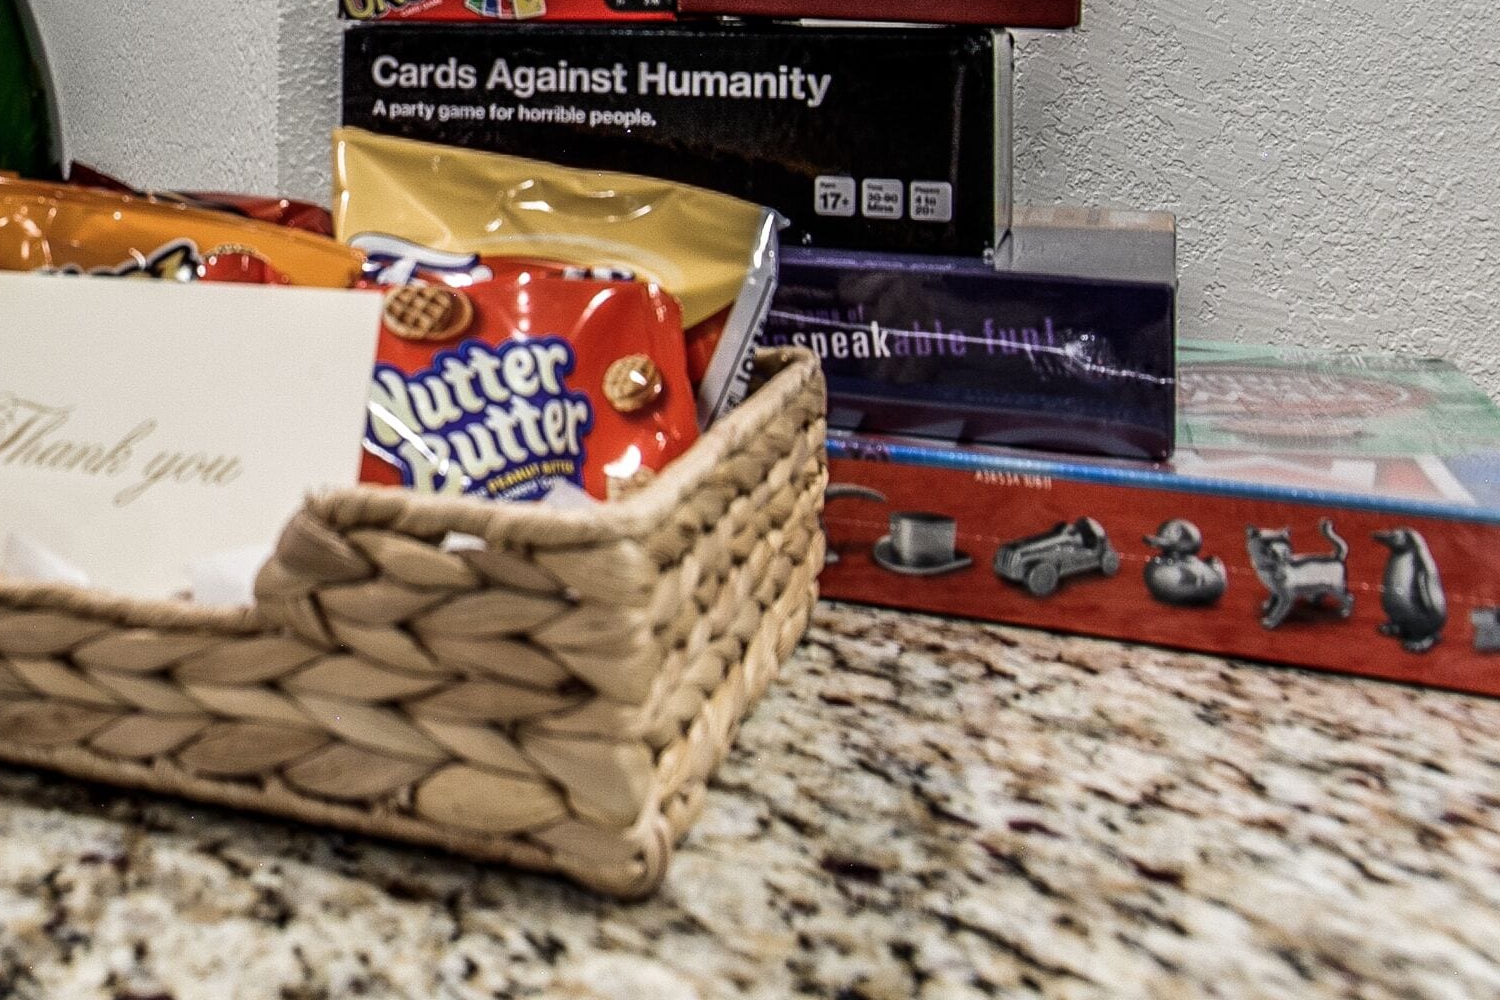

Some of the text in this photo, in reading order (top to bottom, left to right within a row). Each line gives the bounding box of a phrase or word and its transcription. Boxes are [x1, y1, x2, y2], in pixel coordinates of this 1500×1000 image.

[371, 54, 832, 108] Cards Against Humanity
[372, 99, 657, 128] A party game for horrible people.
[820, 191, 850, 210] 17+
[371, 343, 568, 446] Nutter
[112, 437, 243, 508] you
[401, 395, 588, 496] Butter
